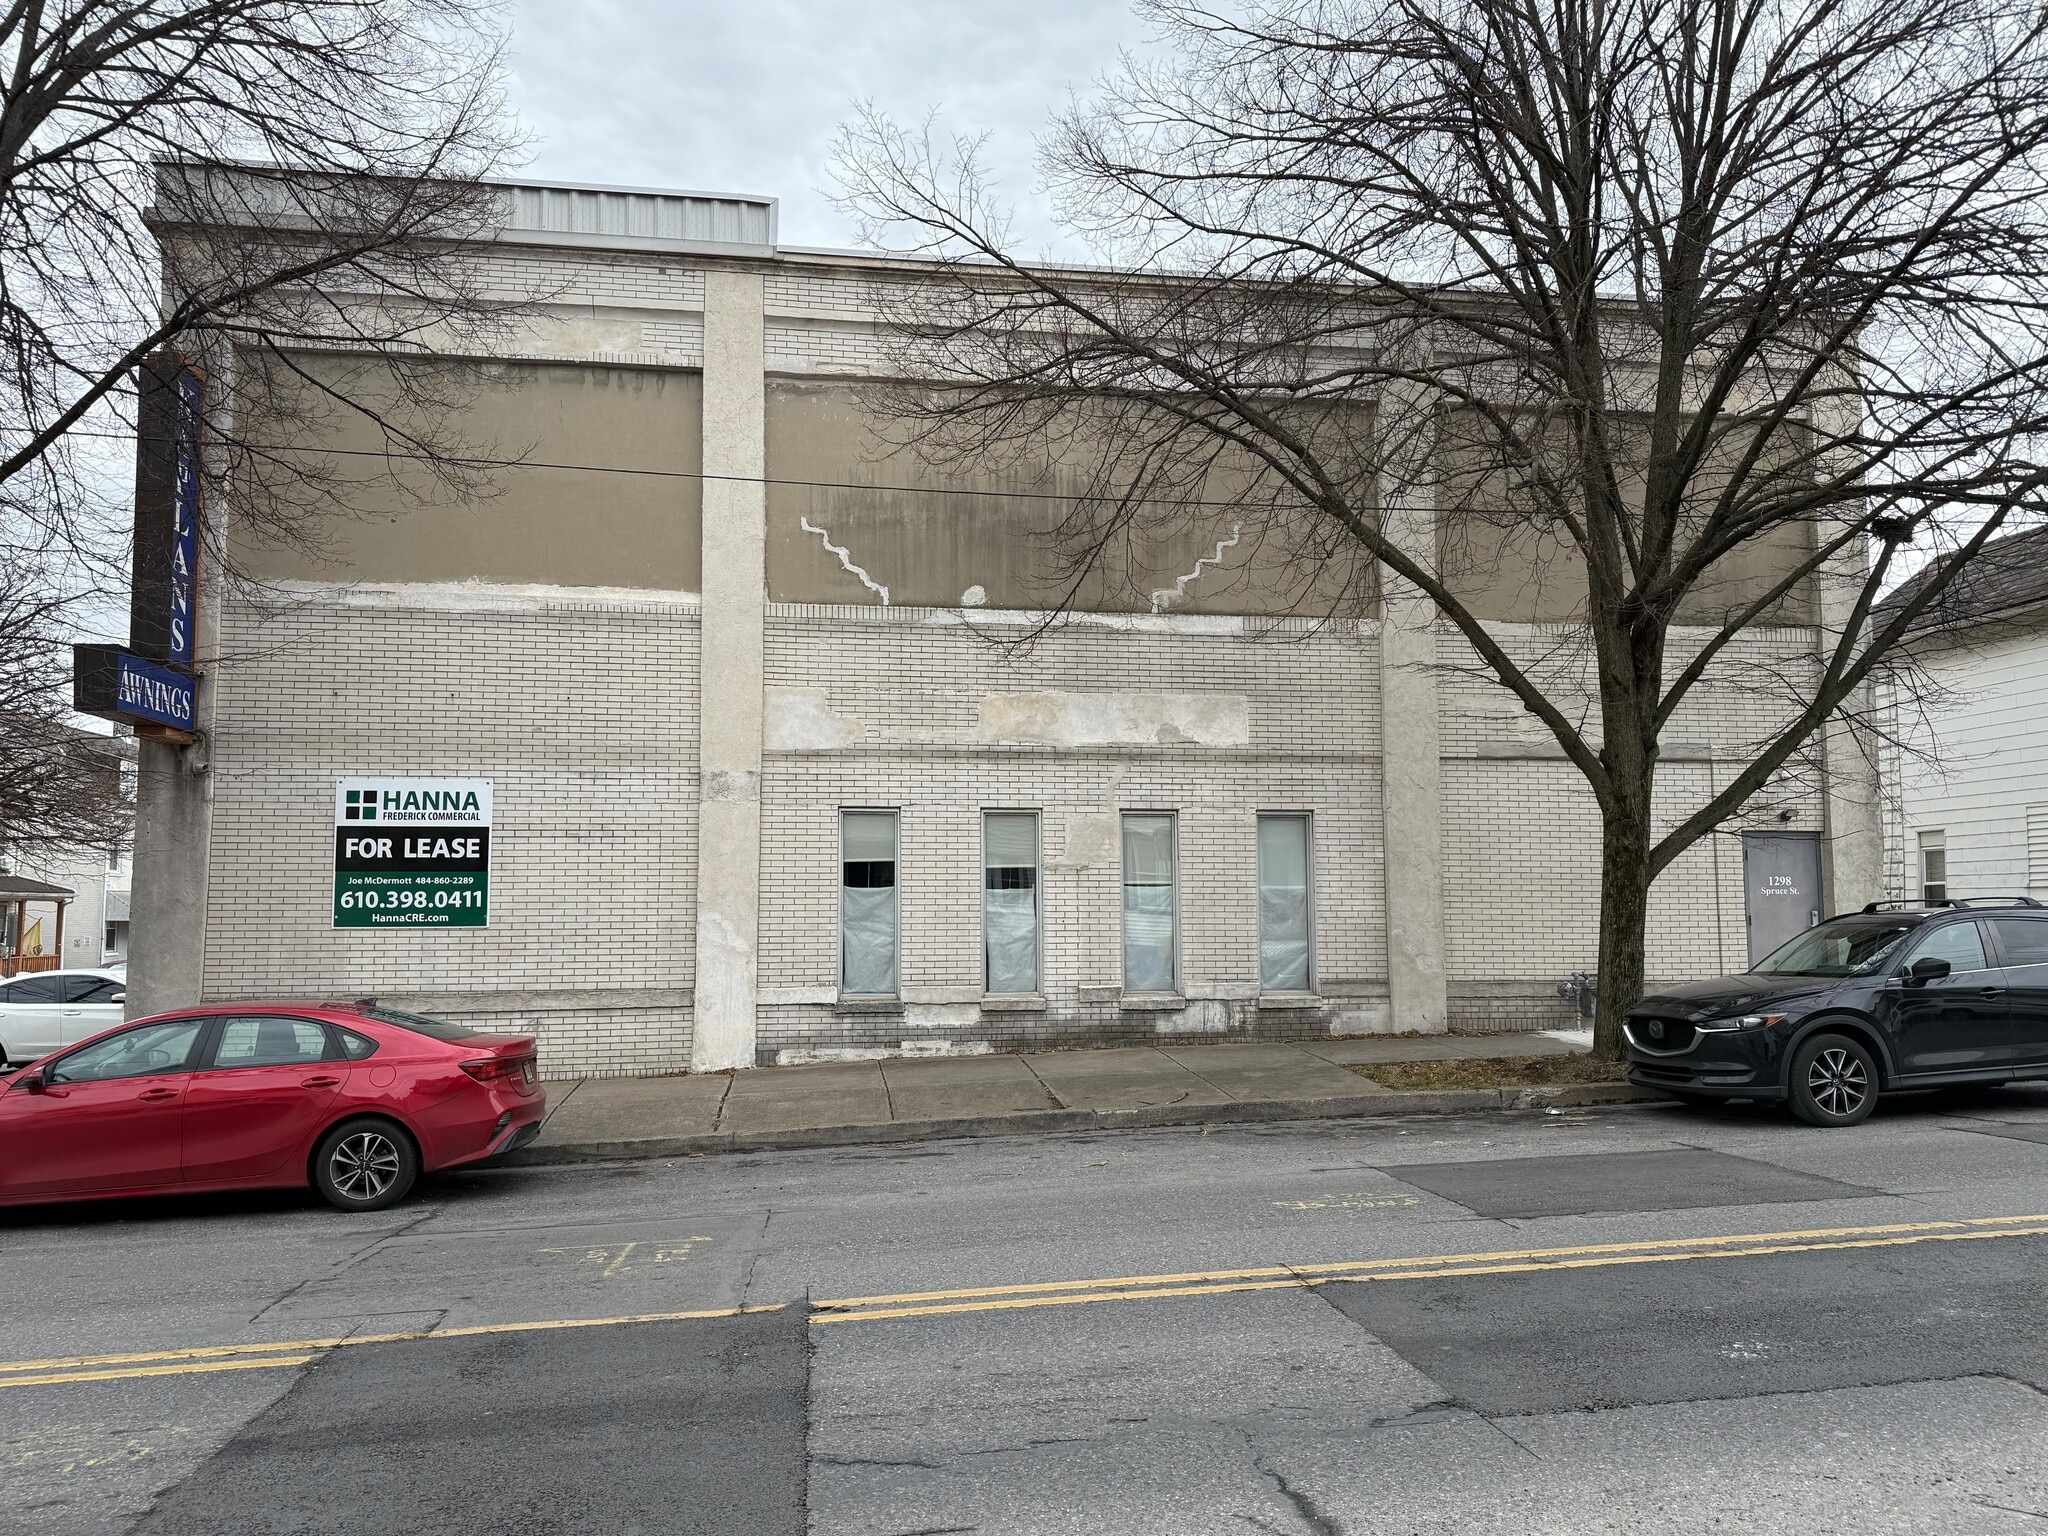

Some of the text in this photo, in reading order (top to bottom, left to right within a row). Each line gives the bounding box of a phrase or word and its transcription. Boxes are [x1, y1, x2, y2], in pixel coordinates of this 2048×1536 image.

[118, 662, 191, 720] AWNINGS
[383, 790, 480, 811] HANNA
[383, 811, 480, 821] FREDERICK COMMERCIAL
[345, 838, 480, 859] FOR LEASE
[348, 877, 474, 885] Joe McDermott 484-860-2289
[1768, 876, 1792, 886] 1298
[1760, 887, 1800, 896] Spruce St.
[340, 890, 482, 909] 610.398.0411
[372, 913, 449, 922] HannaCRE.com
